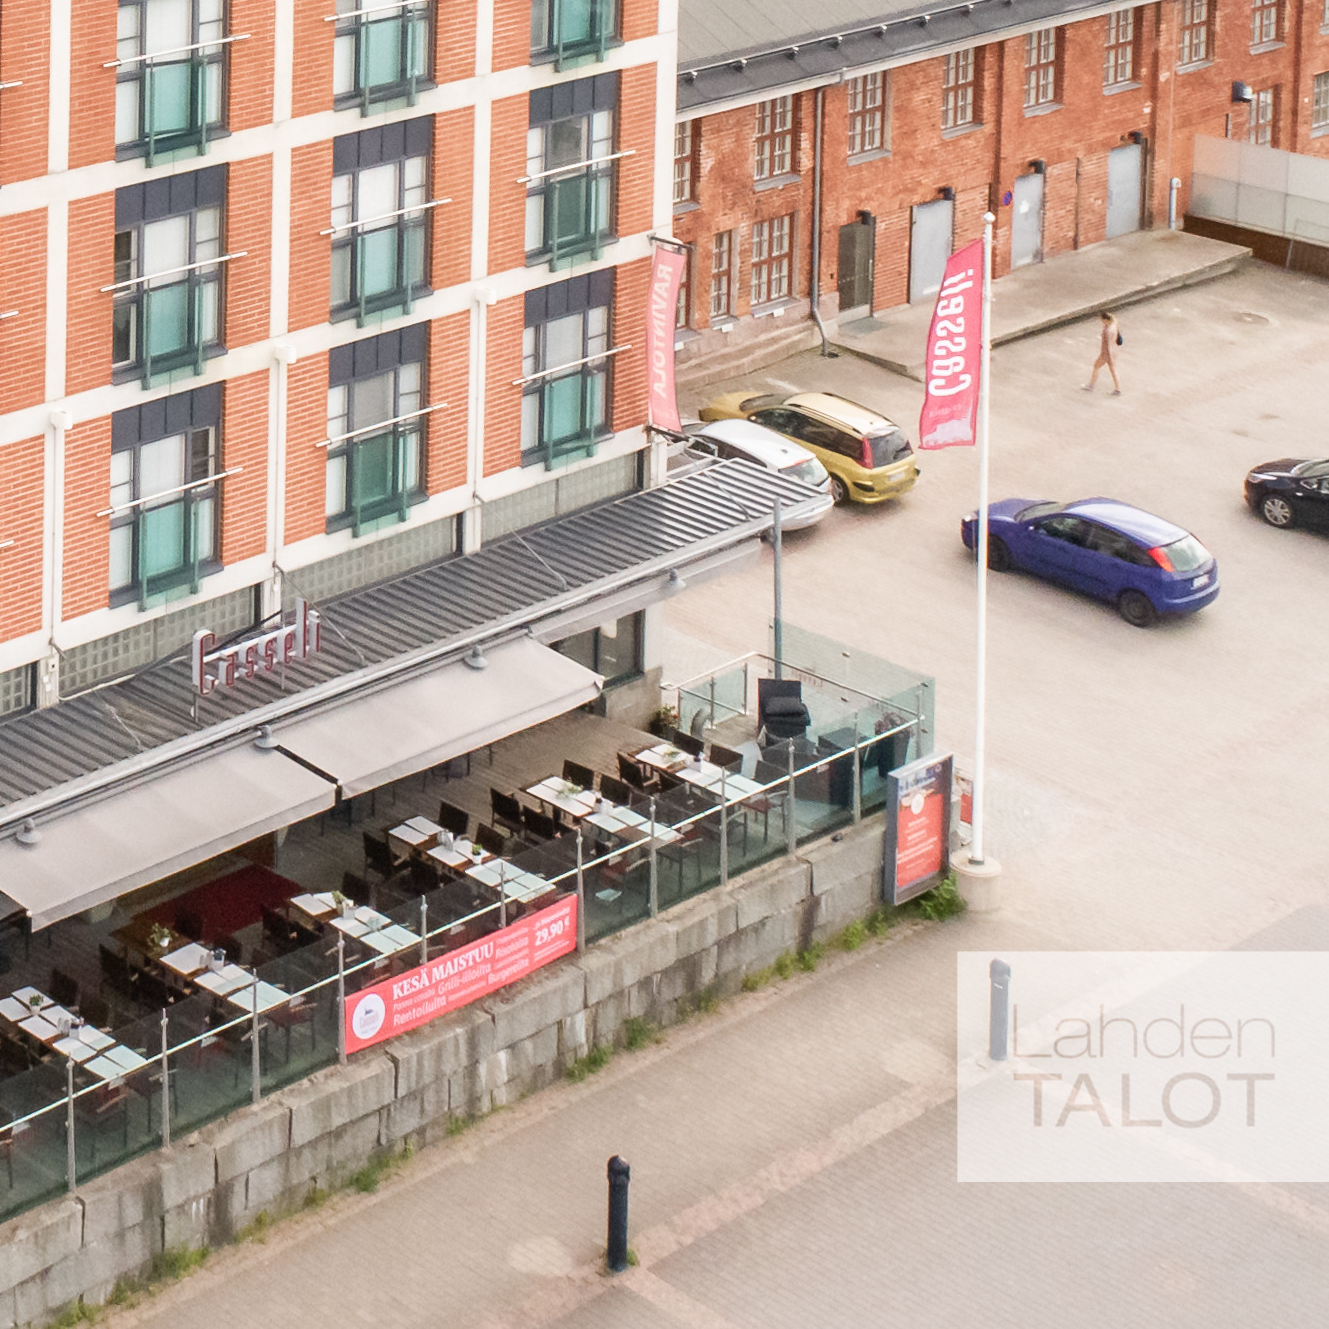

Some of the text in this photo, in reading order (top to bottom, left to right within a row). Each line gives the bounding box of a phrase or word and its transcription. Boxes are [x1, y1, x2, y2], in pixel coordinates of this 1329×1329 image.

[192, 597, 322, 696] Casseli
[392, 968, 430, 1000] KESÄ
[431, 941, 494, 984] MAISTUU
